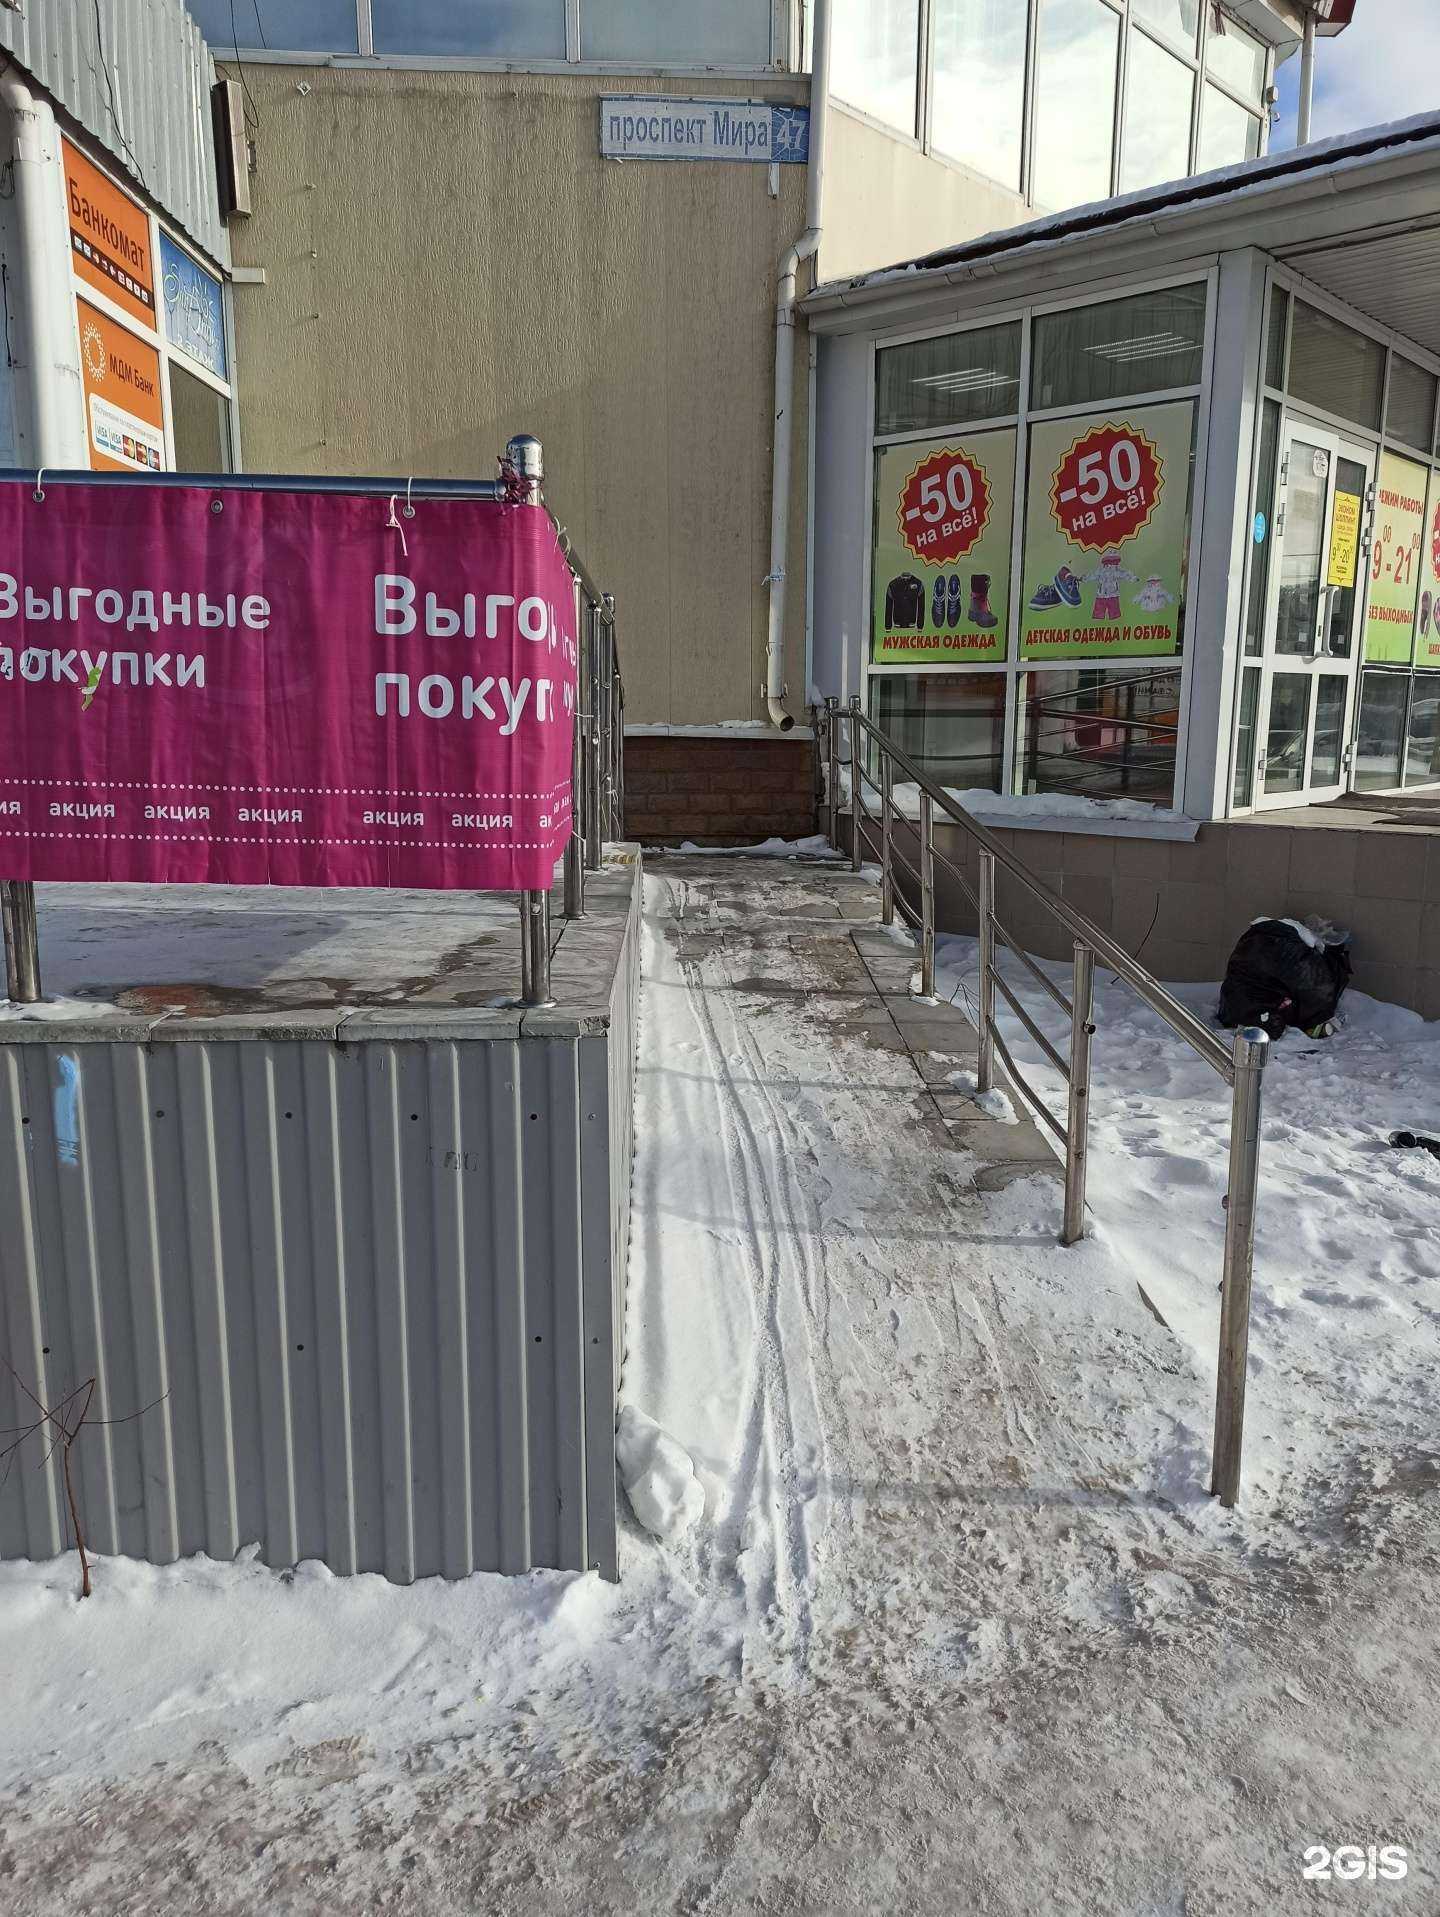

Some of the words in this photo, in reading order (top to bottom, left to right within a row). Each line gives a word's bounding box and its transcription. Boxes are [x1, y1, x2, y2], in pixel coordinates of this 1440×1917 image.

[609, 114, 707, 151] проспект
[712, 111, 769, 155] Мира
[772, 119, 807, 150] 47
[69, 176, 145, 272] Банкомат
[134, 369, 155, 398] Банк
[906, 463, 973, 523] -50
[1059, 438, 1141, 505] -50
[916, 528, 937, 548] на
[942, 506, 979, 538] всё!
[1072, 512, 1097, 532] на
[1103, 486, 1147, 521] всё!
[0, 572, 271, 632] Выгодные
[882, 634, 940, 650] МУЖСКАЯ
[943, 633, 997, 650] ОДЕЖДА
[1025, 627, 1070, 646] ДЕТСКАЯ
[1072, 627, 1121, 643] ОДЕЖДА
[1122, 626, 1131, 641] И
[1133, 624, 1172, 641] ОБУВЬ
[49, 802, 116, 820] акция
[144, 804, 211, 822] акция
[237, 807, 304, 825] акция
[362, 810, 425, 827] акция
[451, 812, 513, 831] акция
